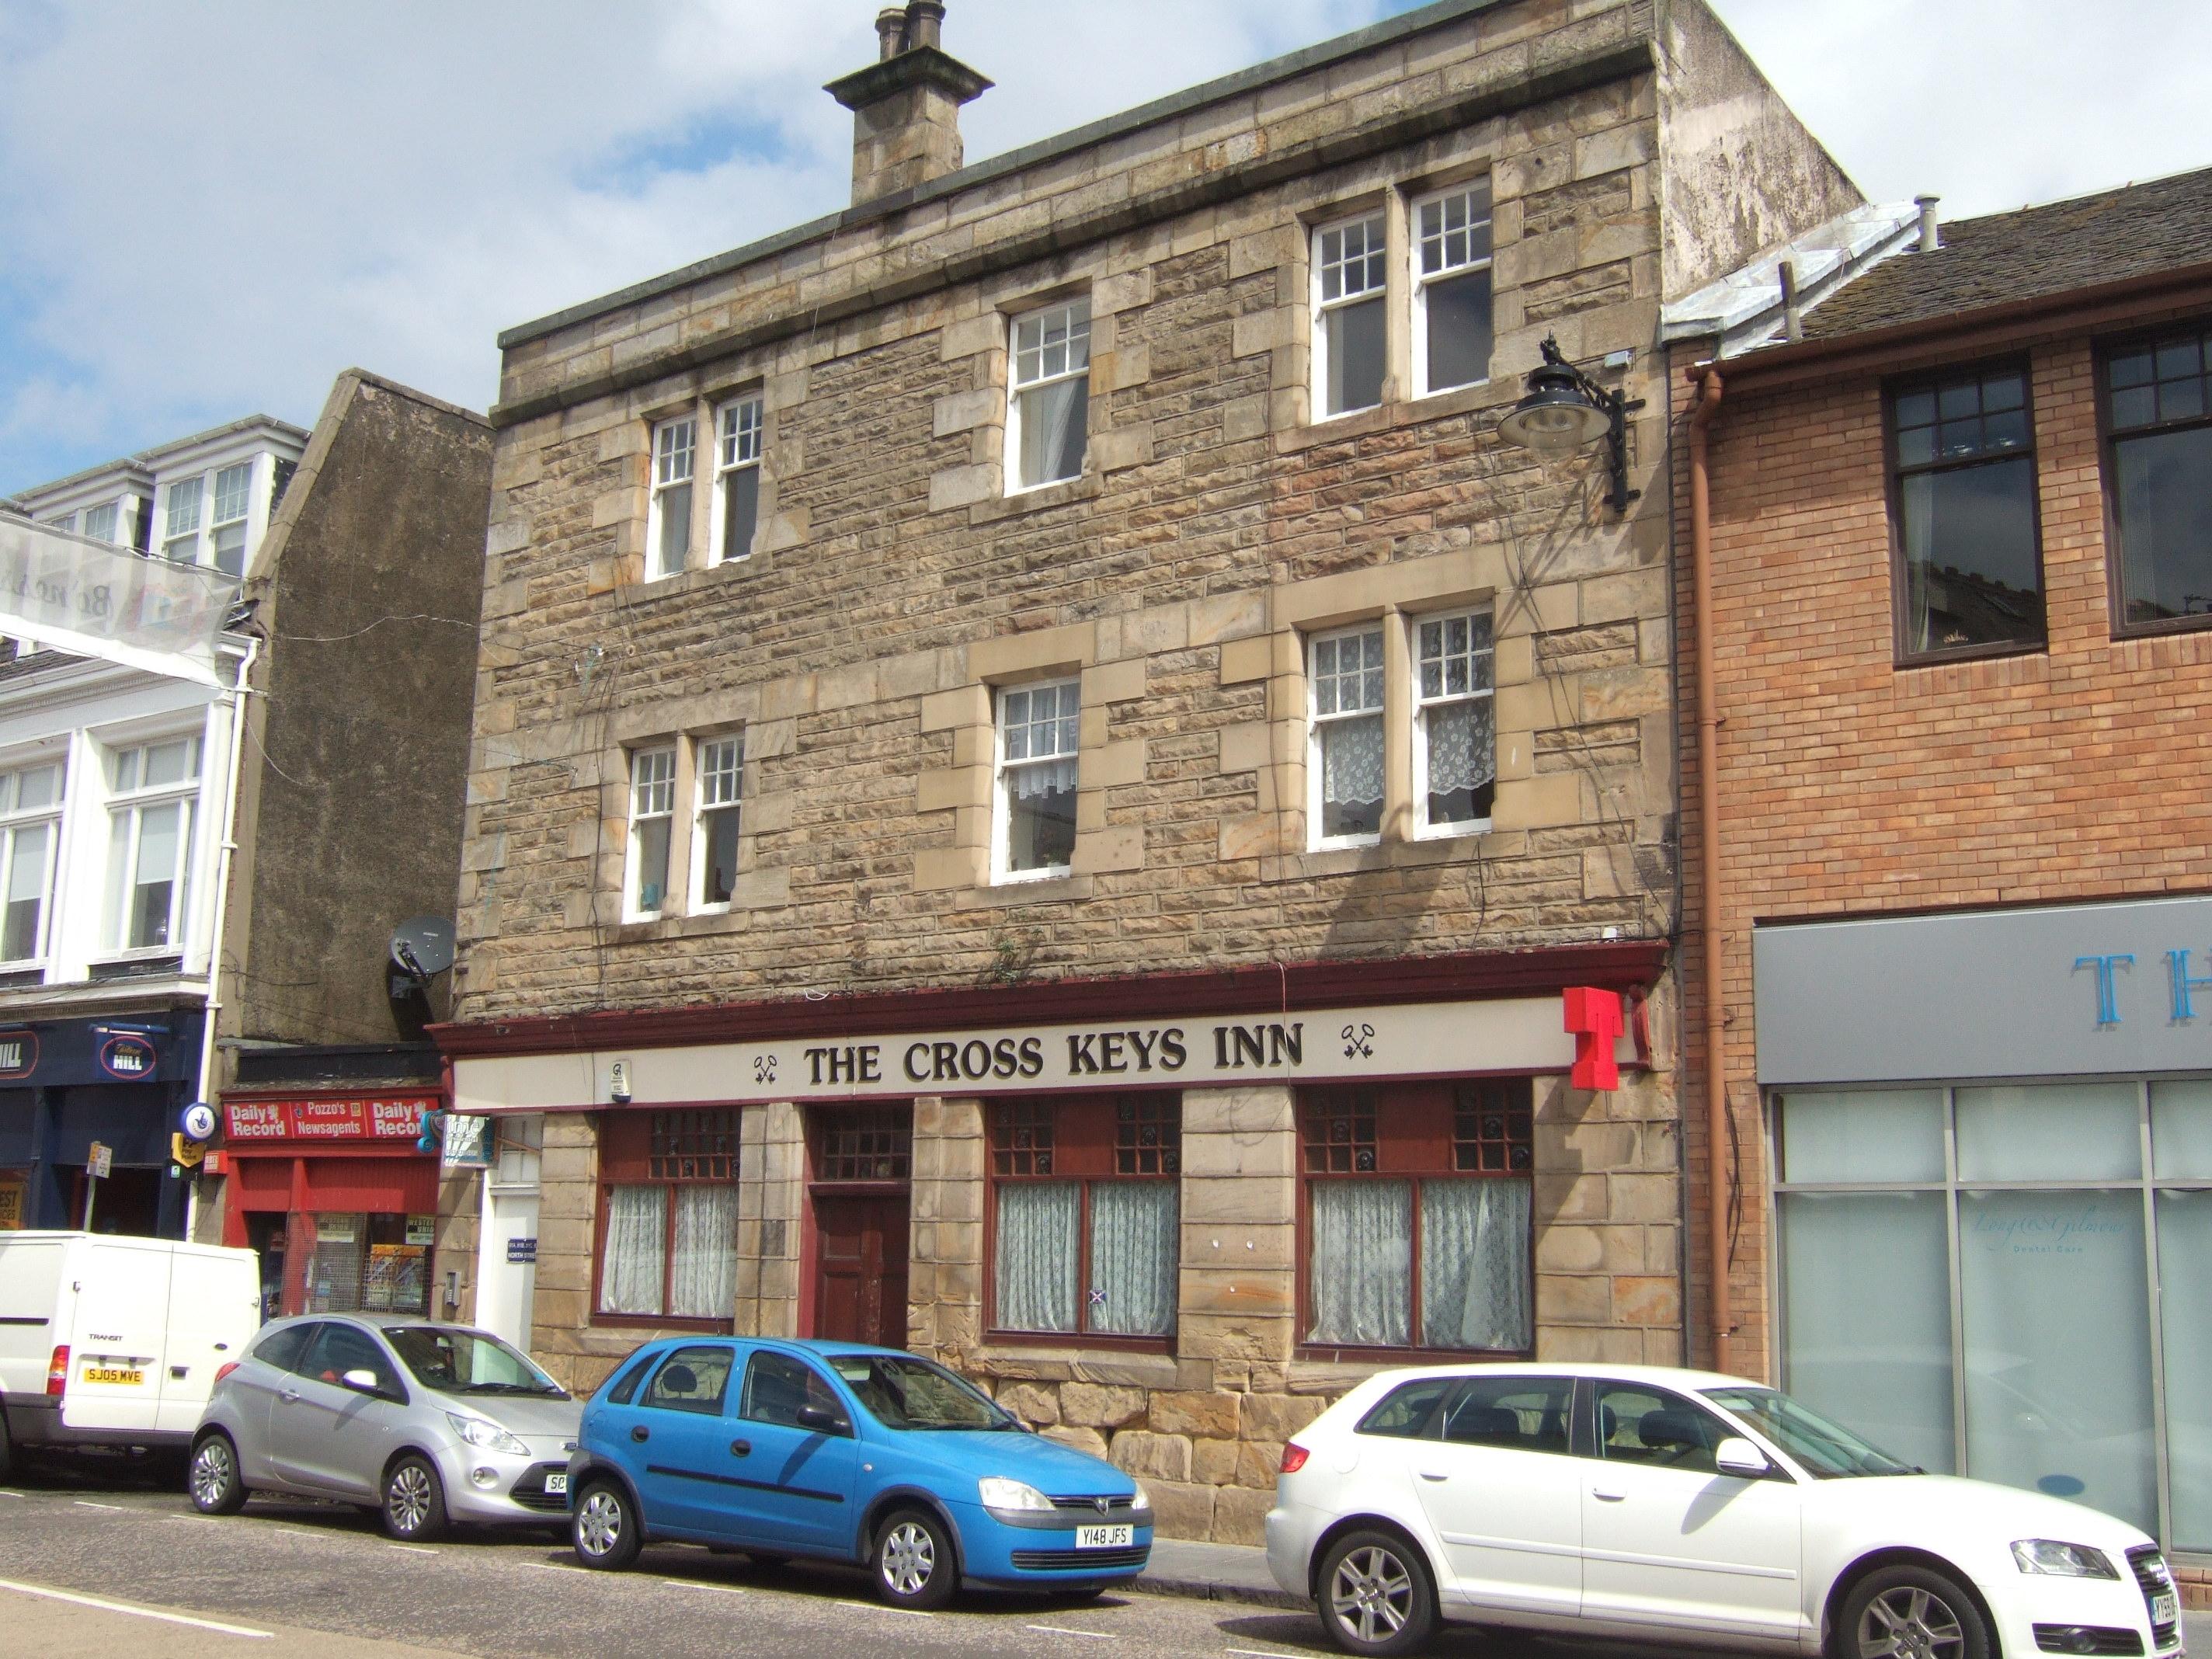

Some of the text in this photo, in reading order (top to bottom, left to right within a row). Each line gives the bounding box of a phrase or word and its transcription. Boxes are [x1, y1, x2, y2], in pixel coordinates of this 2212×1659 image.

[803, 1022, 1304, 1086] THE CROSS KEYS INN
[113, 1055, 142, 1070] HILL
[230, 1105, 266, 1123] Daily
[307, 1101, 346, 1115] Pozzo's
[373, 1101, 412, 1122] Daily
[232, 1121, 286, 1136] Record
[297, 1122, 360, 1137] Newsagents
[374, 1119, 423, 1136] Recor
[89, 1334, 123, 1342] TRANSIT
[89, 1369, 141, 1382] SJ05 MVE
[1083, 1527, 1127, 1545] Y148 JFS
